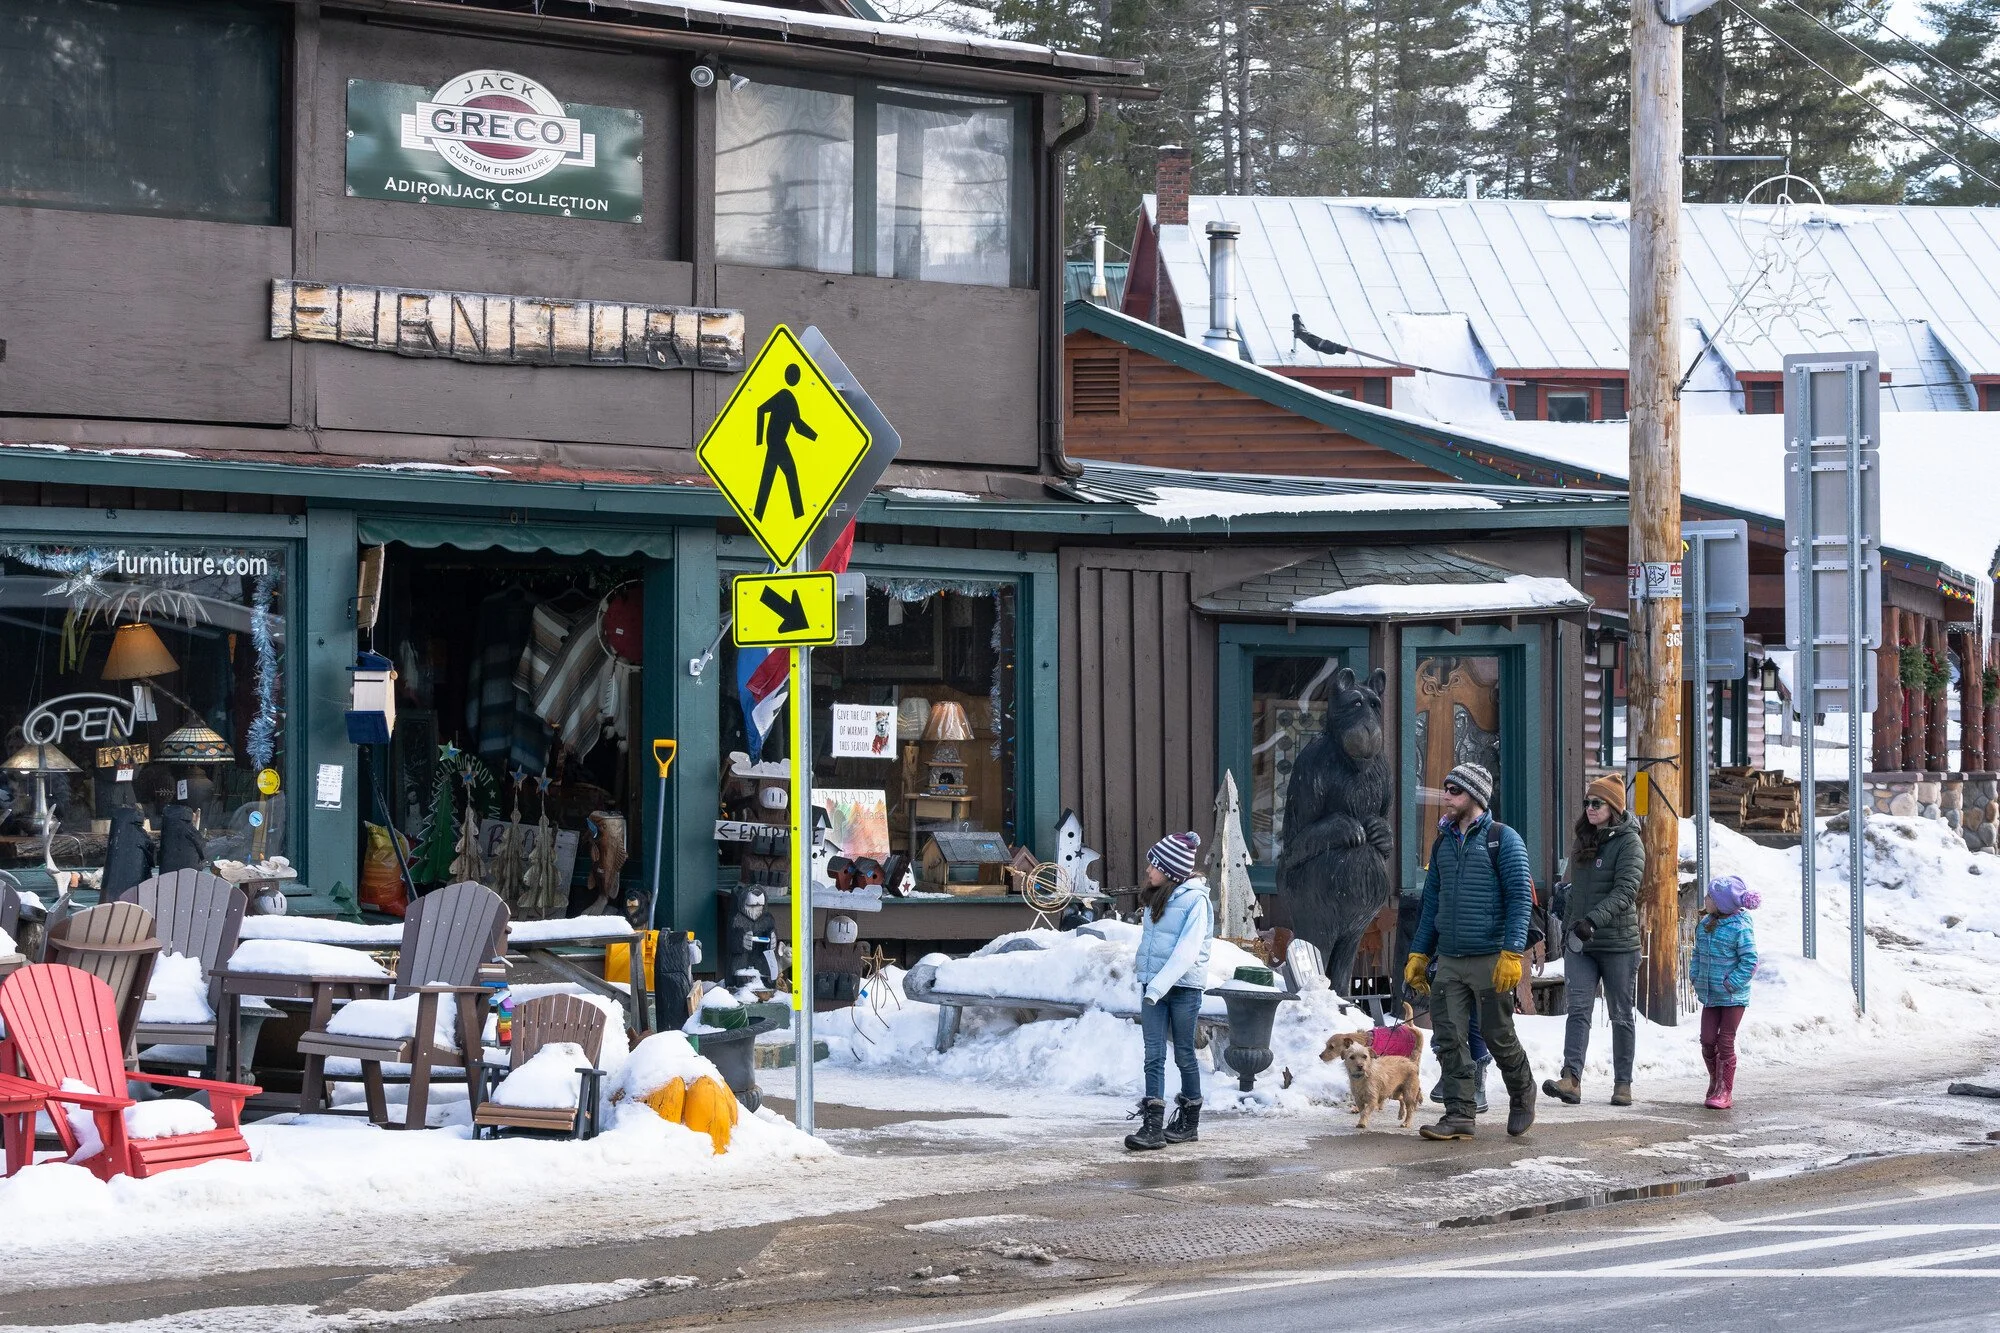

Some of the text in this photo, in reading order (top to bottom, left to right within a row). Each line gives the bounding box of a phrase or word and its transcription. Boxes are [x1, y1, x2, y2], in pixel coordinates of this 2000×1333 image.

[464, 76, 536, 100] JACK
[431, 108, 567, 146] GRECO
[449, 145, 552, 177] CUSTOM FURNITURE
[501, 188, 609, 211] COLLECTION
[291, 280, 730, 368] FURNITURE
[116, 550, 268, 576] furniture.com
[29, 706, 136, 745] OPEN
[837, 708, 872, 721] GIVE THE GIFT
[839, 725, 869, 737] OF WARMTH
[839, 741, 870, 752] THIS SEASON
[832, 790, 875, 804] TRADE
